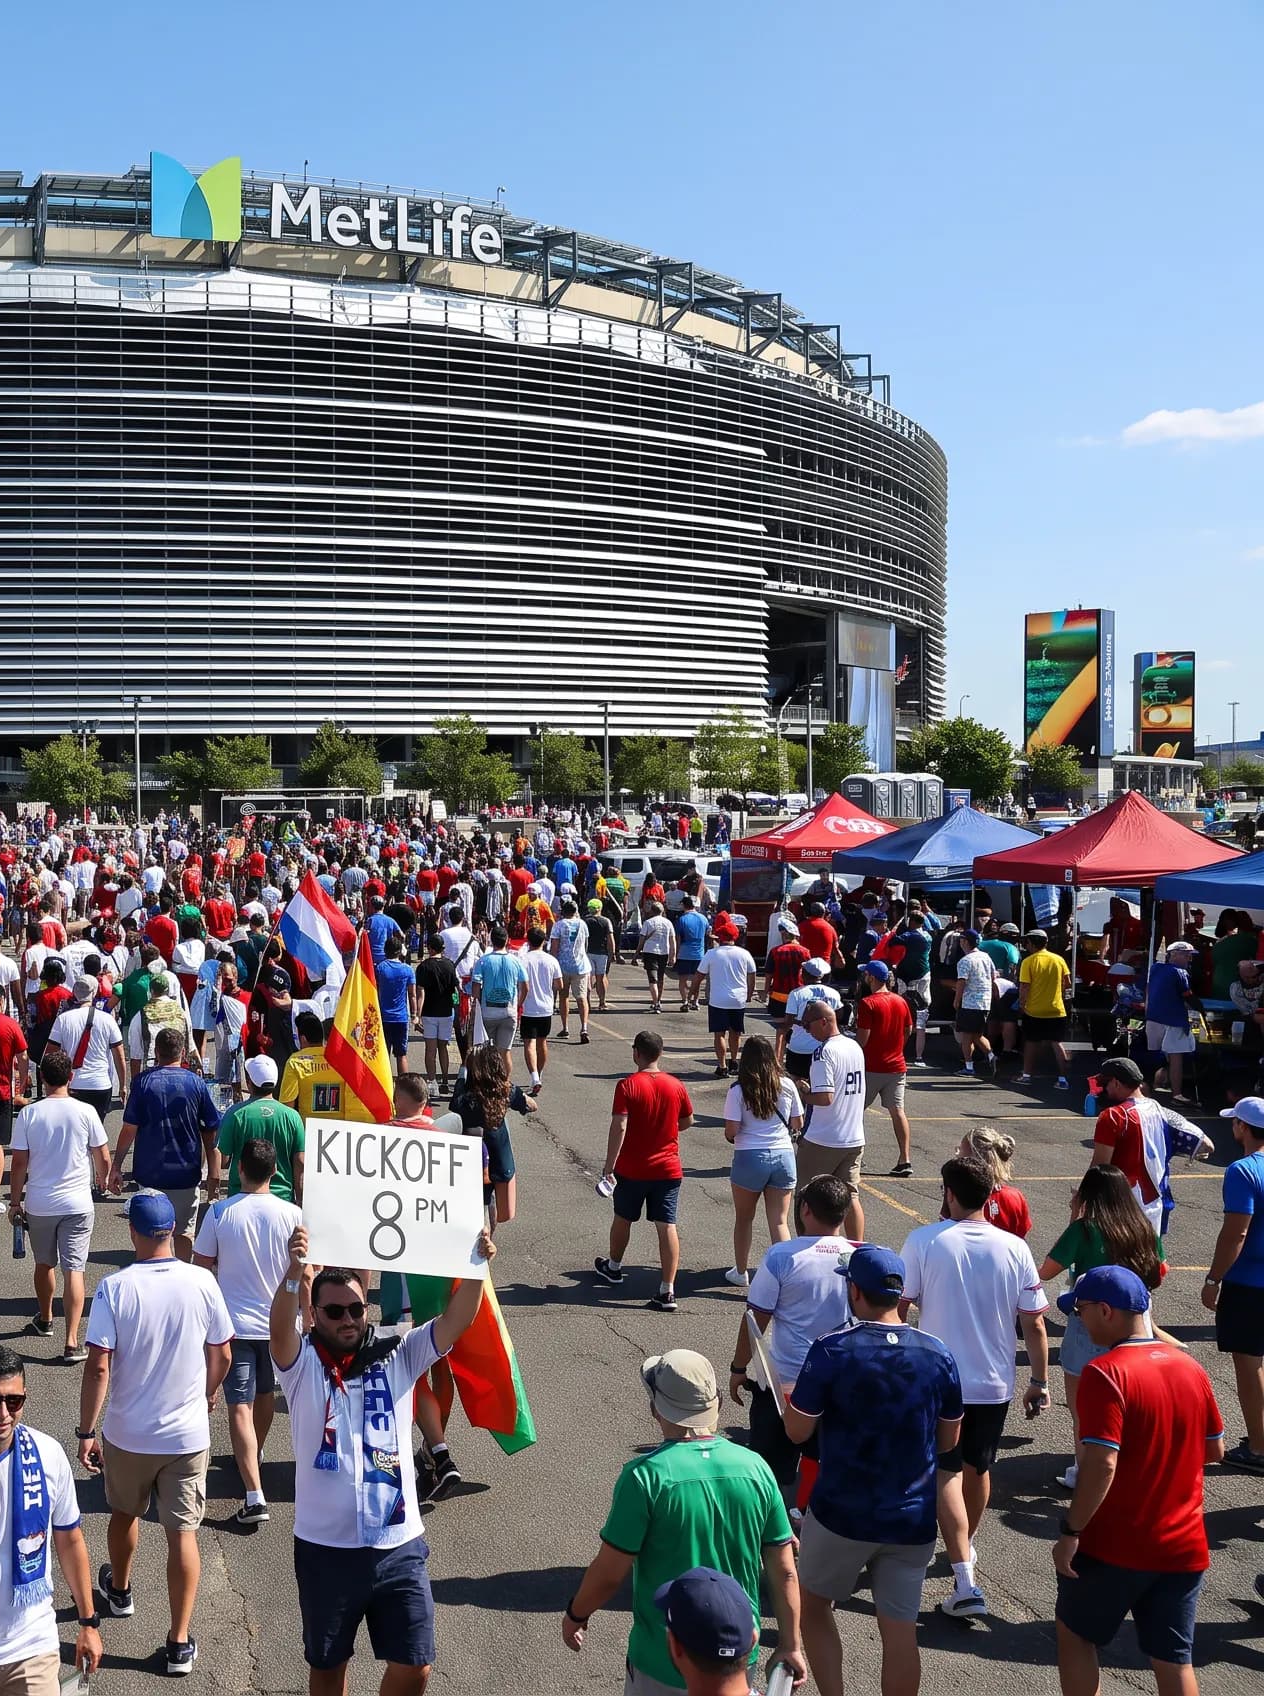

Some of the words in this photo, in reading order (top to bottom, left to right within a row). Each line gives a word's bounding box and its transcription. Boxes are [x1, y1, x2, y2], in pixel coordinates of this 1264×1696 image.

[270, 182, 502, 264] MetLife
[316, 1129, 470, 1187] KICKOFF
[369, 1190, 406, 1261] 8
[415, 1197, 448, 1224] PM
